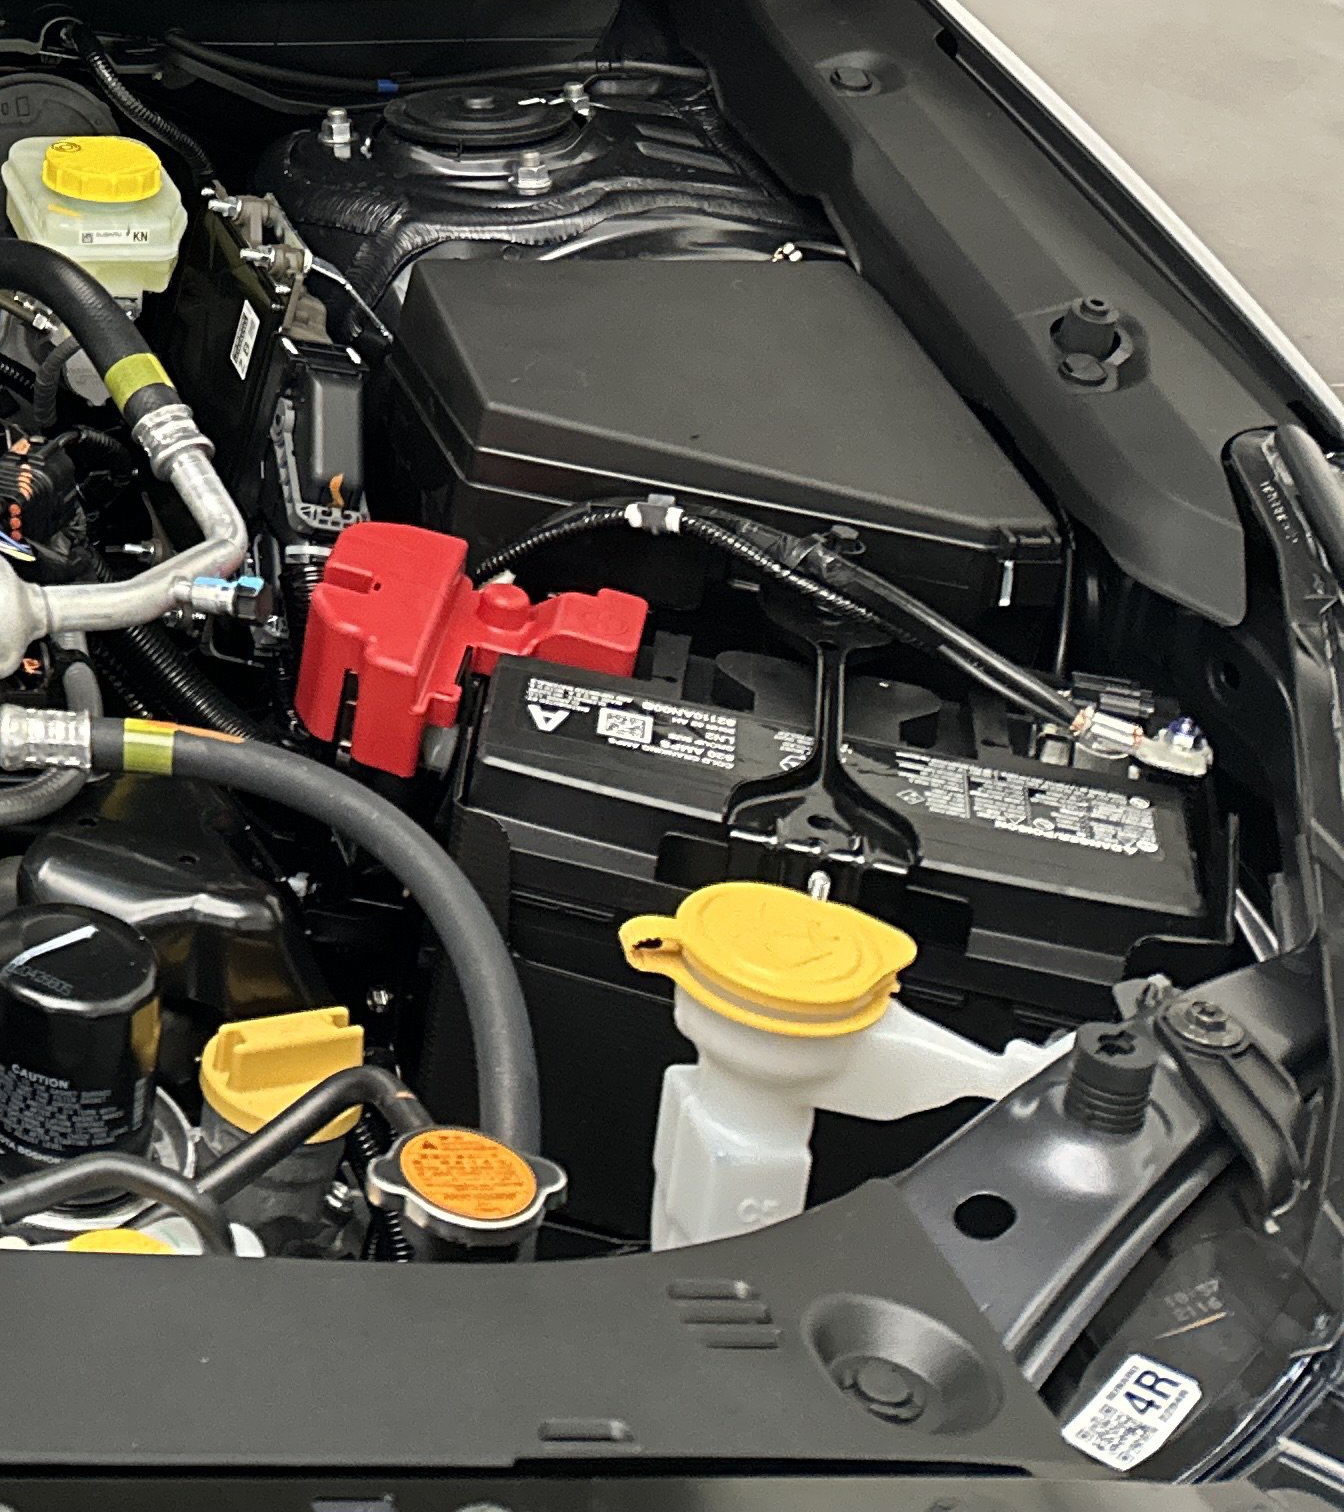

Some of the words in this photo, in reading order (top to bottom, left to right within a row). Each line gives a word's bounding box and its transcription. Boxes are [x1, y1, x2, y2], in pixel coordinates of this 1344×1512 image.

[133, 231, 148, 242] KN
[659, 739, 705, 756] AMPS
[11, 1063, 69, 1089] CAUTION
[1123, 1369, 1182, 1415] 4R
